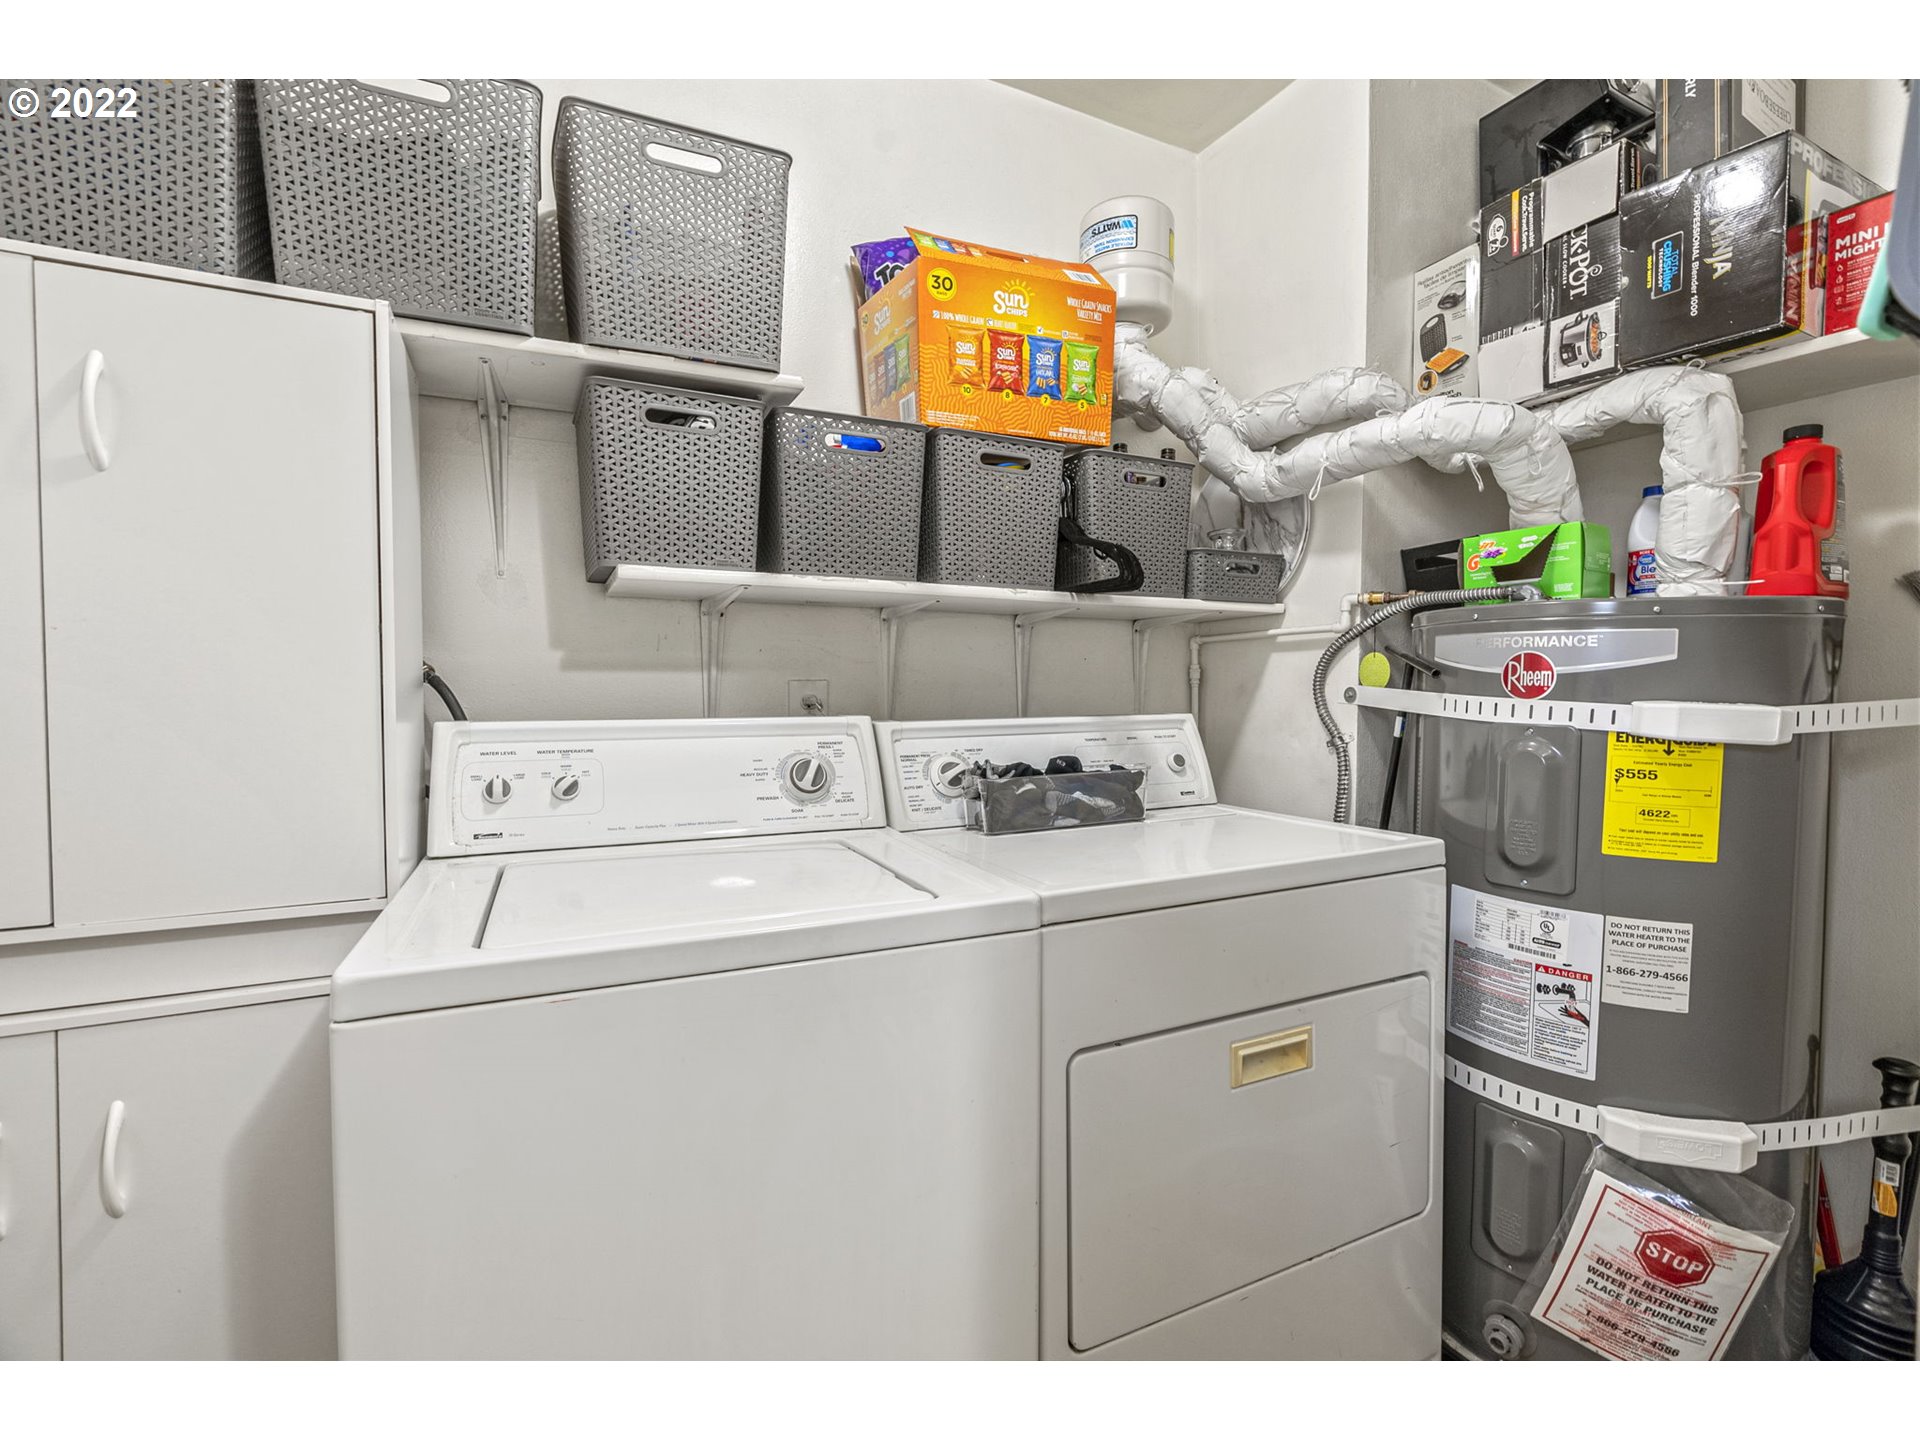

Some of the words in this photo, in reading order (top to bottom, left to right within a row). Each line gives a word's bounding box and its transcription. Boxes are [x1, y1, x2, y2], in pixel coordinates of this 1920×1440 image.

[1091, 220, 1121, 238] WATTS
[1692, 193, 1701, 261] PROFESSIONAL
[1835, 225, 1880, 251] MINI
[1662, 240, 1673, 292] CRUSHING
[1671, 248, 1679, 275] TOTAL
[931, 274, 953, 292] 30
[1691, 260, 1700, 294] Blender
[993, 289, 1029, 315] Sun
[1690, 294, 1699, 317] 1000
[1005, 307, 1028, 317] CHIPS
[956, 341, 976, 354] Sun
[996, 347, 1016, 360] Sun
[1036, 353, 1055, 366] Sun
[1073, 358, 1090, 371] Sun
[963, 386, 972, 394] 10
[1005, 391, 1010, 399] 8
[1641, 566, 1656, 574] Ble
[1508, 653, 1552, 693] Rheem
[1615, 767, 1659, 781] $555
[1638, 808, 1671, 818] 4622
[1608, 930, 1635, 939] WATER
[1636, 933, 1664, 942] HEATER
[1642, 925, 1673, 935] RETURN
[1611, 939, 1634, 947] PLACE
[1648, 943, 1687, 953] PURCHASE
[1548, 967, 1590, 981] DANGER
[1606, 965, 1689, 982] 1-866-279-4566
[1645, 1241, 1704, 1276] STOP
[1595, 1257, 1613, 1272] DO
[1615, 1263, 1643, 1284] NOT
[1642, 1278, 1695, 1308] RETURN
[1693, 1298, 1720, 1315] THIS
[1586, 1264, 1628, 1293] WATER
[1630, 1284, 1677, 1312] HEATER
[1677, 1304, 1694, 1318] TO
[1693, 1310, 1718, 1328] THE
[1586, 1277, 1625, 1302] PLACE
[1625, 1296, 1643, 1310] OF
[1643, 1305, 1708, 1336] PURCHASE
